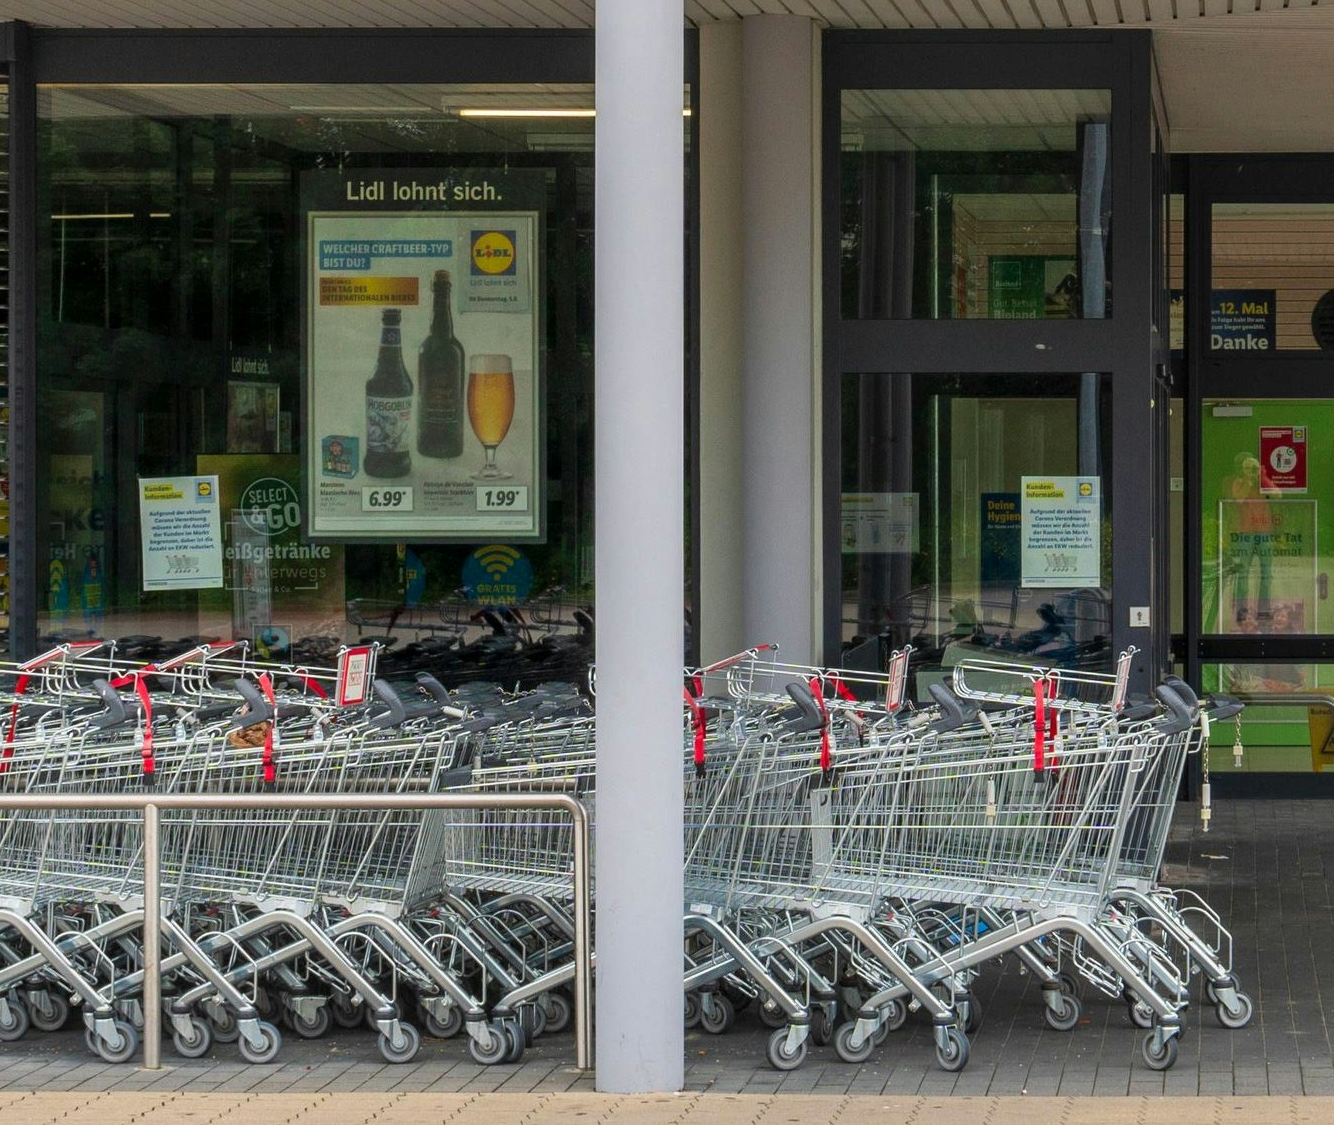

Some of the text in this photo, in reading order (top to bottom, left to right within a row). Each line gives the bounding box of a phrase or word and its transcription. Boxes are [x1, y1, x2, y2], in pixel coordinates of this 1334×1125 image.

[347, 181, 503, 201] Lidl lohnt sich.
[323, 243, 449, 254] WELCHER CRAFTBEER-TYP
[475, 245, 511, 259] LIDL
[323, 258, 366, 268] BIST DU?
[1219, 302, 1268, 315] 12. Mal
[1211, 334, 1269, 350] Danke
[248, 487, 288, 504] SELECT
[987, 500, 1016, 510] Deine
[1230, 532, 1303, 545] Die gute Tat
[225, 543, 331, 562] eißgetränke
[1230, 546, 1303, 557] am Automat
[477, 584, 517, 593] GRATIS
[477, 595, 516, 605] WLAN
